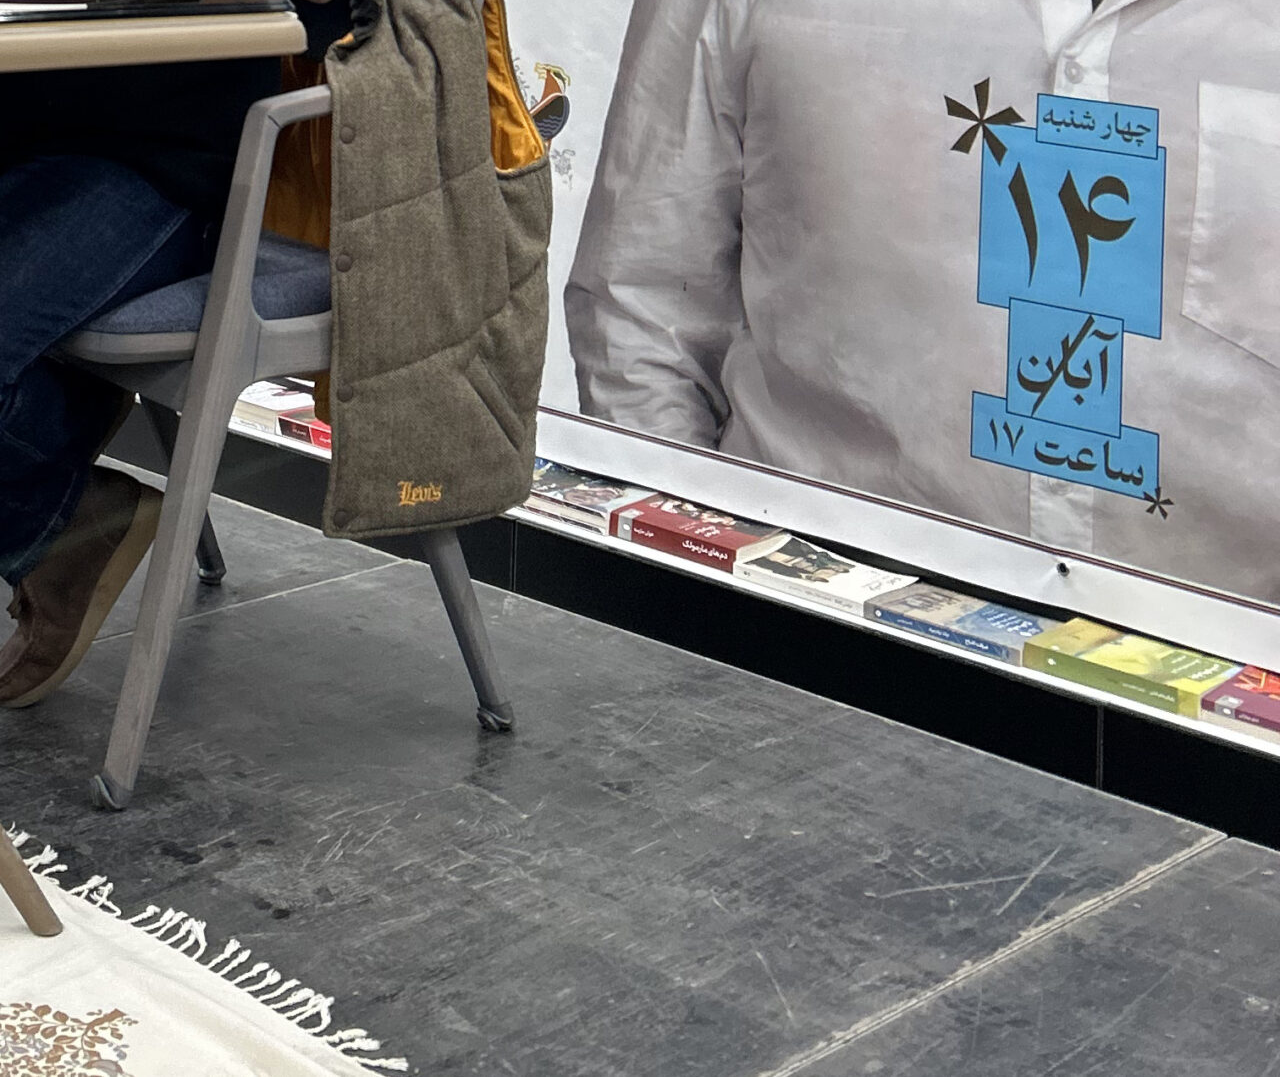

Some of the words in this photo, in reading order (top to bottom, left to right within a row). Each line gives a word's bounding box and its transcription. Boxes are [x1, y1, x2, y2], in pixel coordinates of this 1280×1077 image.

[1008, 160, 1136, 298] ۱۴
[1017, 326, 1119, 406] آبان
[987, 417, 1024, 457] ۱۷
[1033, 440, 1145, 487] ساعت
